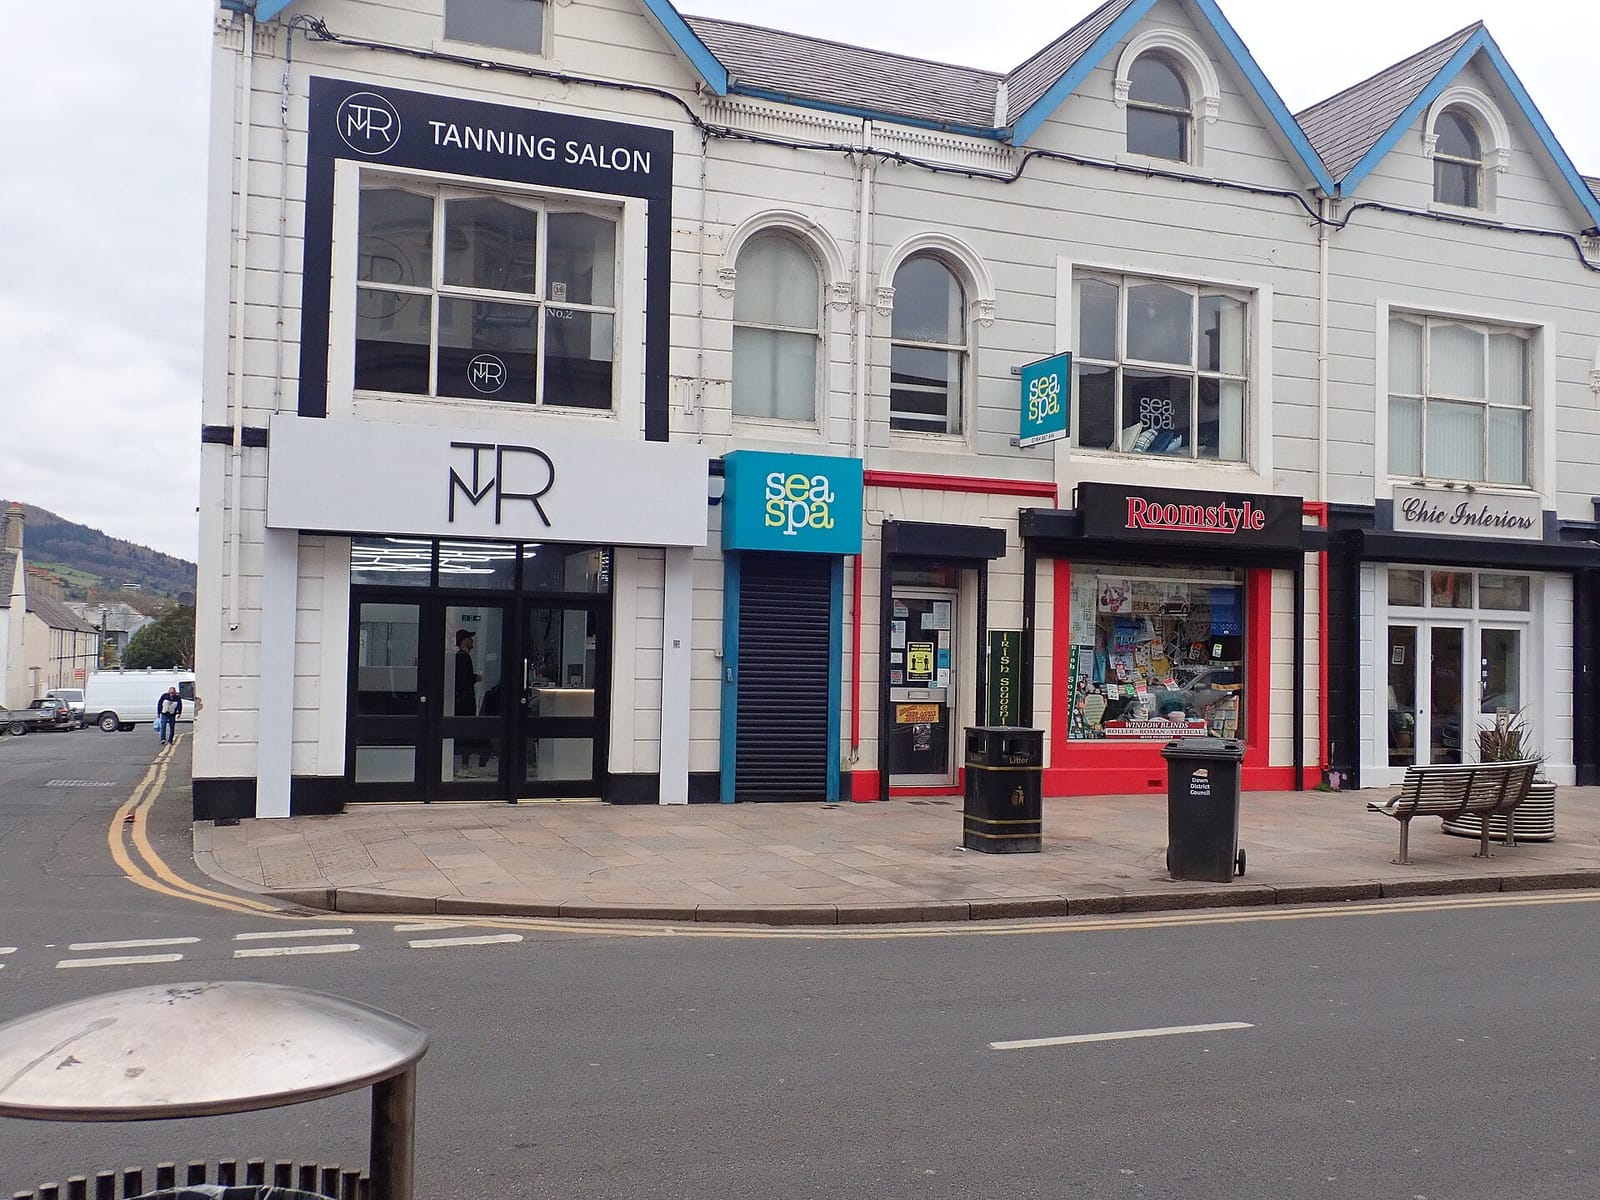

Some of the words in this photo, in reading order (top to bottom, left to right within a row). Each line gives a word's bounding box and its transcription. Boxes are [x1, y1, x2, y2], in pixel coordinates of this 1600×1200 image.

[428, 120, 556, 161] TANNING
[564, 141, 652, 175] SALON
[546, 308, 573, 319] No.2
[1029, 375, 1060, 400] sea
[1028, 397, 1060, 425] spa
[1139, 397, 1176, 415] sea
[1139, 413, 1176, 430] spa
[765, 472, 835, 504] sea
[765, 500, 835, 536] spa
[1125, 496, 1266, 534] Roomstyle
[1402, 497, 1448, 523] Chic
[1450, 501, 1536, 530] Interiors
[1125, 721, 1160, 729] WINDOW
[1160, 721, 1189, 729] BLINDS
[1009, 756, 1029, 765] Litter
